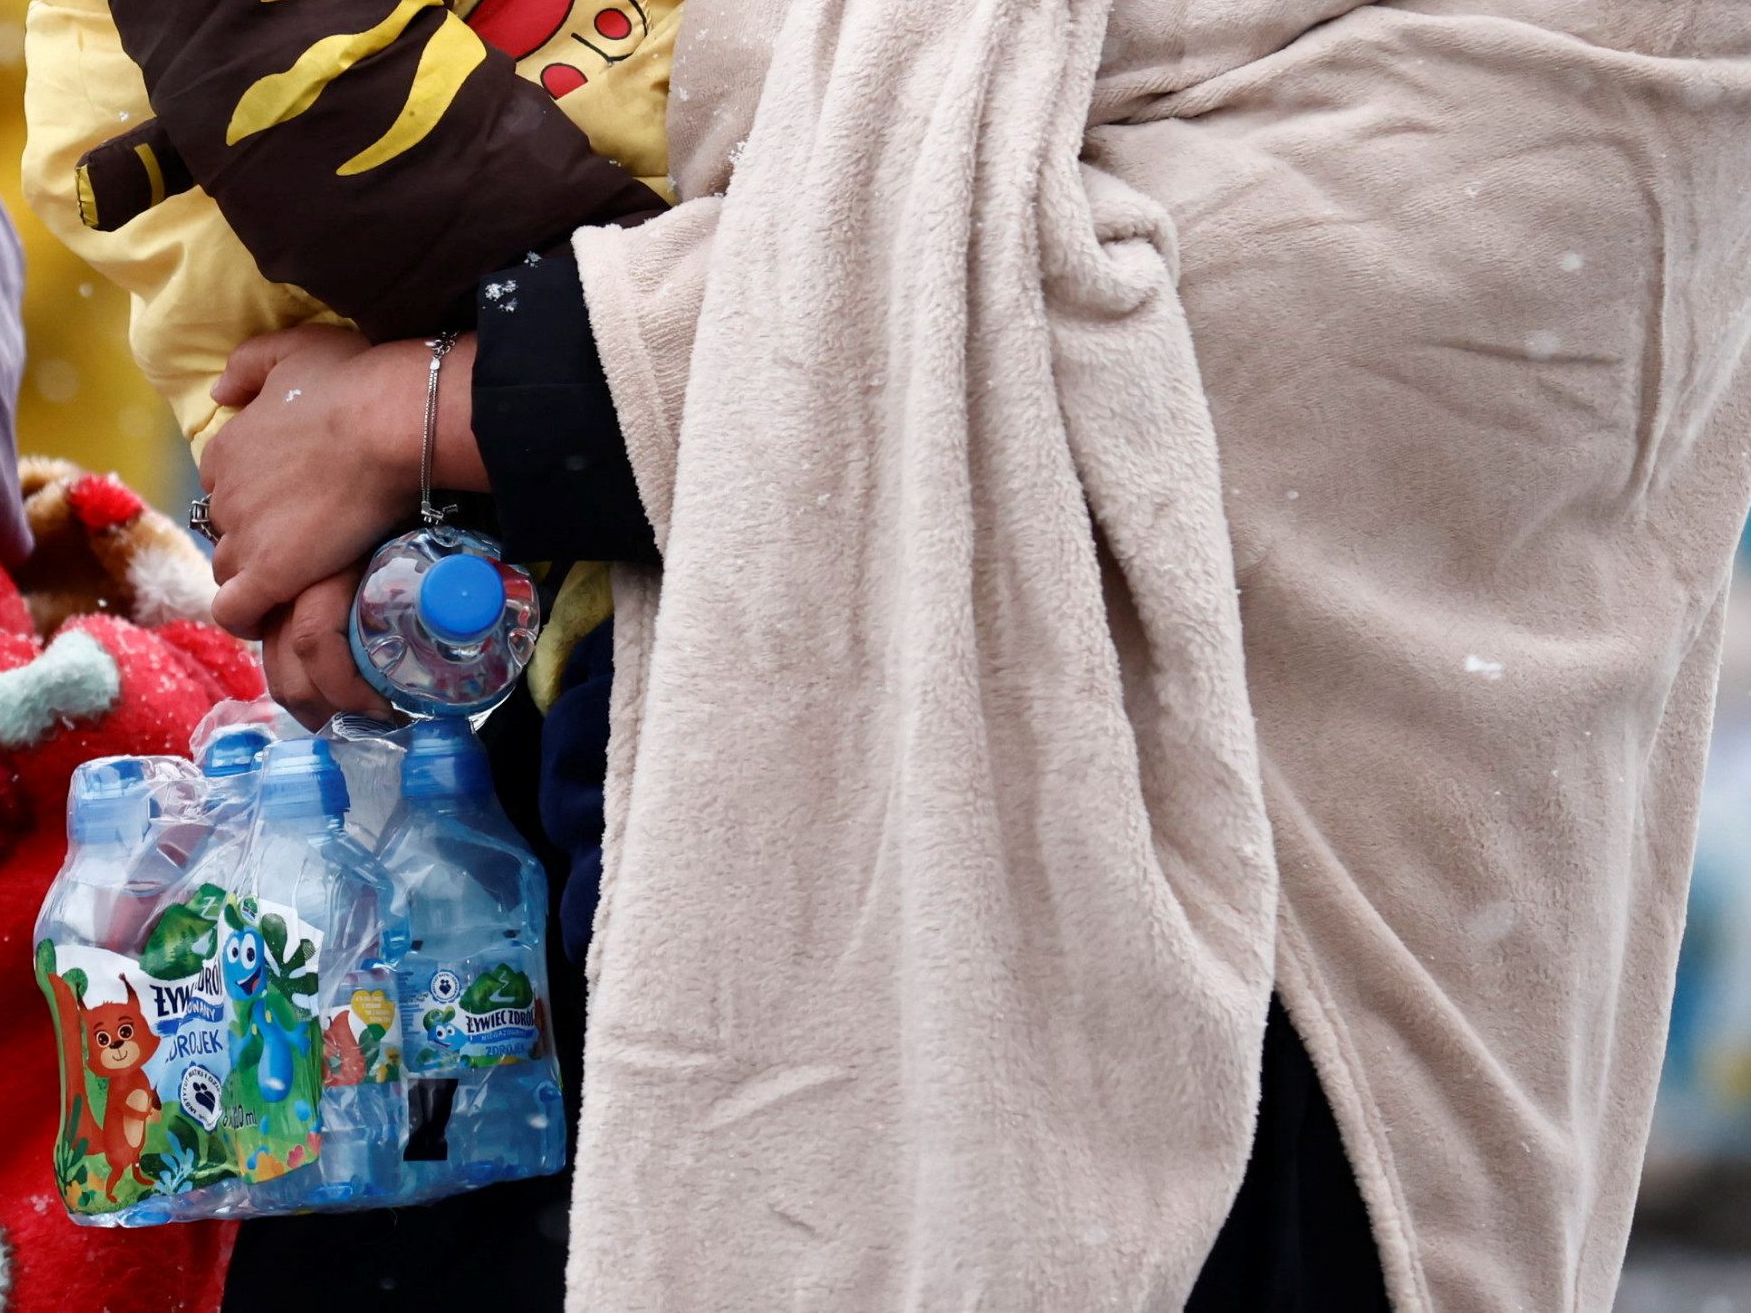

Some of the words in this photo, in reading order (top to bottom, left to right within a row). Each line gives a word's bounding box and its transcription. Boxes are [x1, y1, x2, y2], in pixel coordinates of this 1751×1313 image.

[149, 984, 194, 1017] ŻYW
[465, 1009, 507, 1034] ŻYWIEC
[165, 1028, 224, 1064] DROJEK
